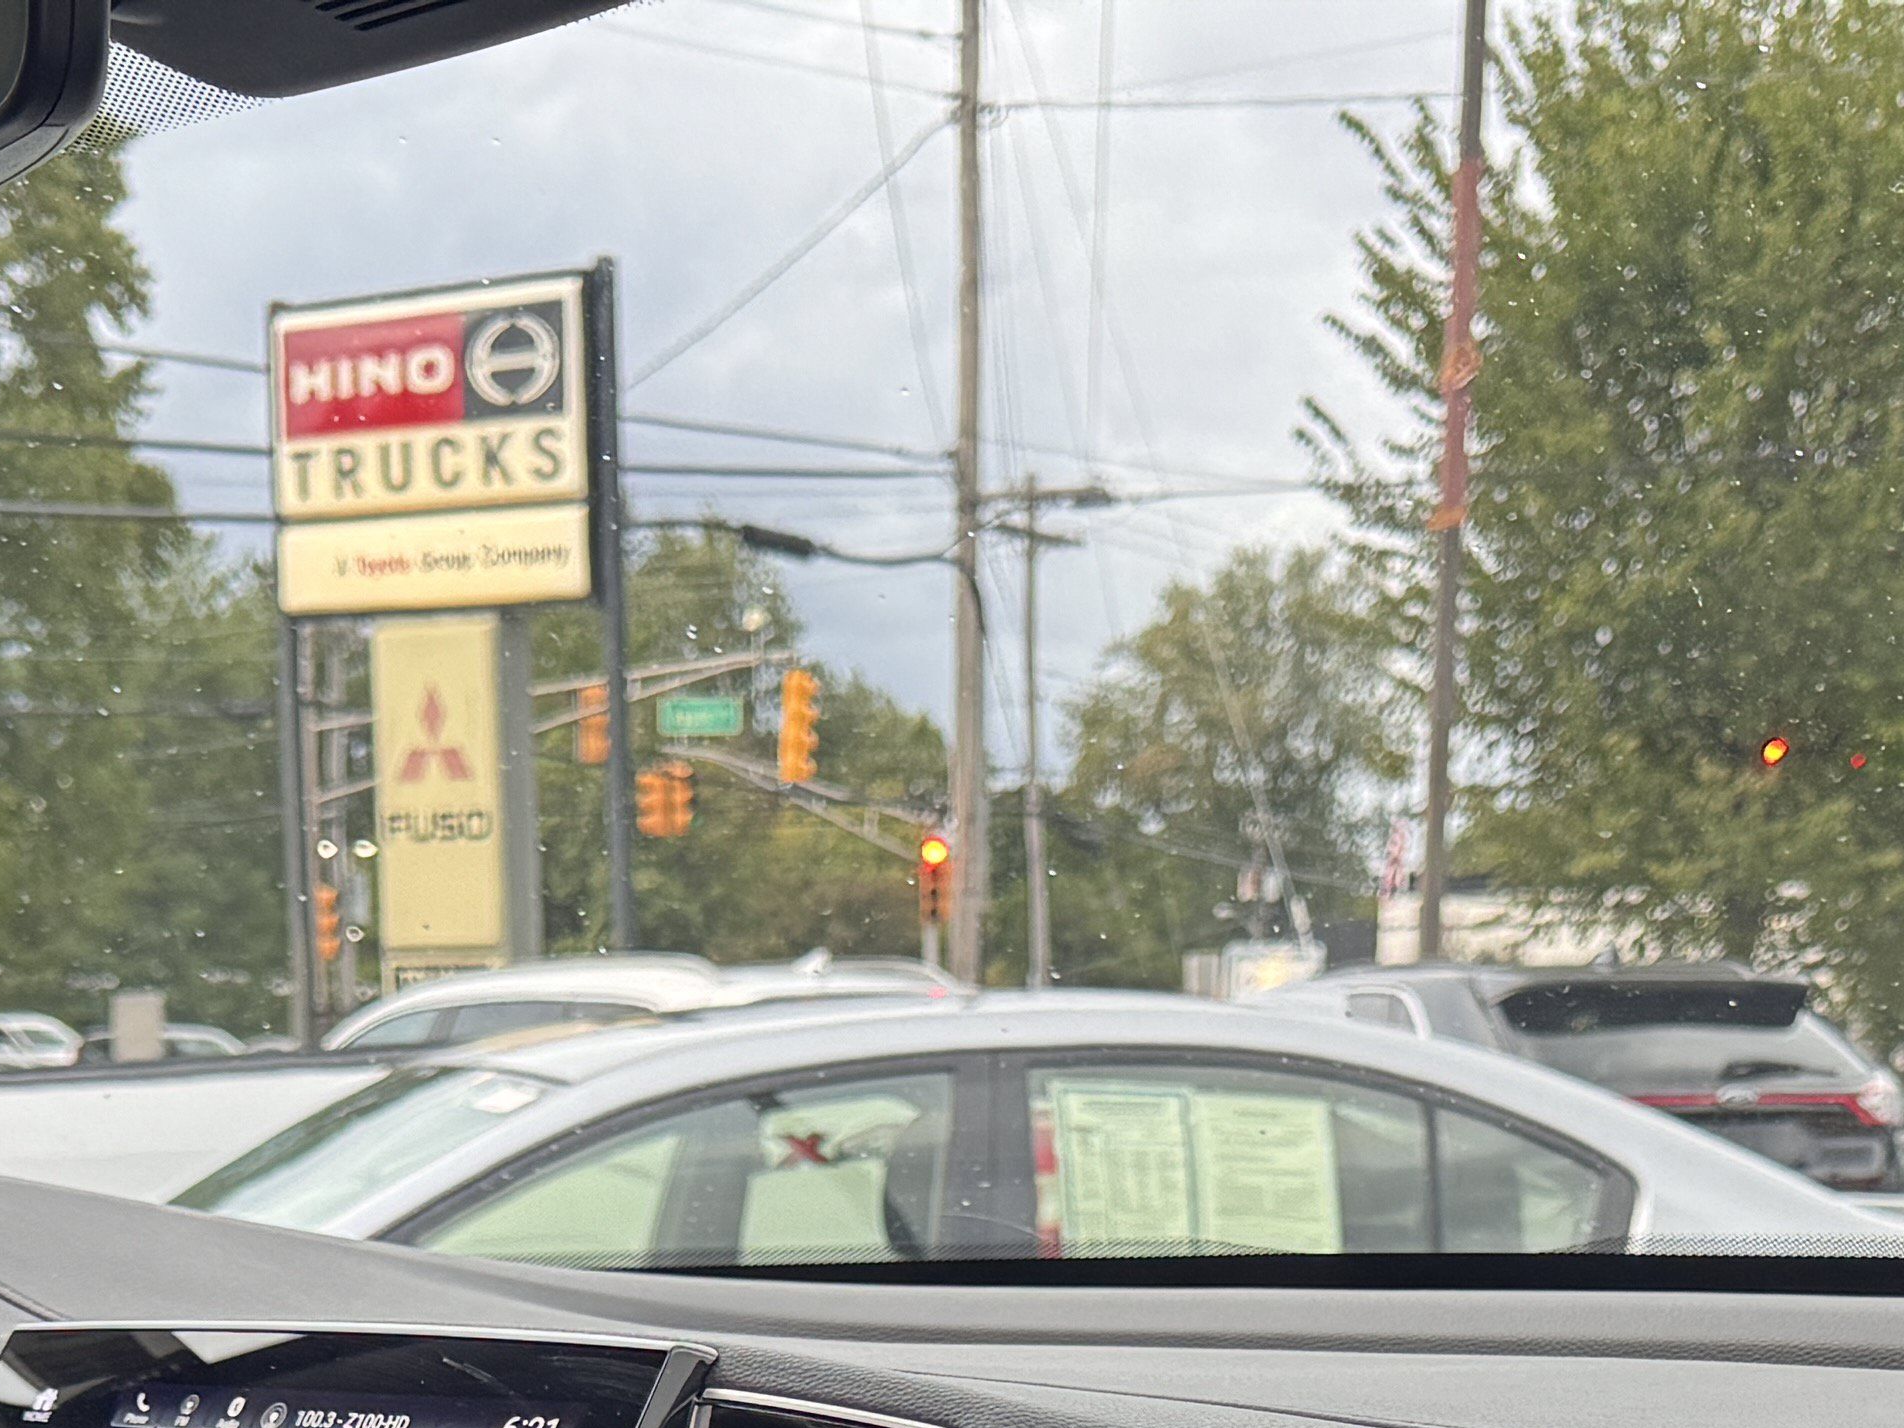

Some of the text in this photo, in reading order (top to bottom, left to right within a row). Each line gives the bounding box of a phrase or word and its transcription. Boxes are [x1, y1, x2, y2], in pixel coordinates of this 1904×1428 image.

[288, 343, 456, 404] HINO
[291, 427, 562, 502] TRUCKS
[382, 808, 495, 843] FUSO
